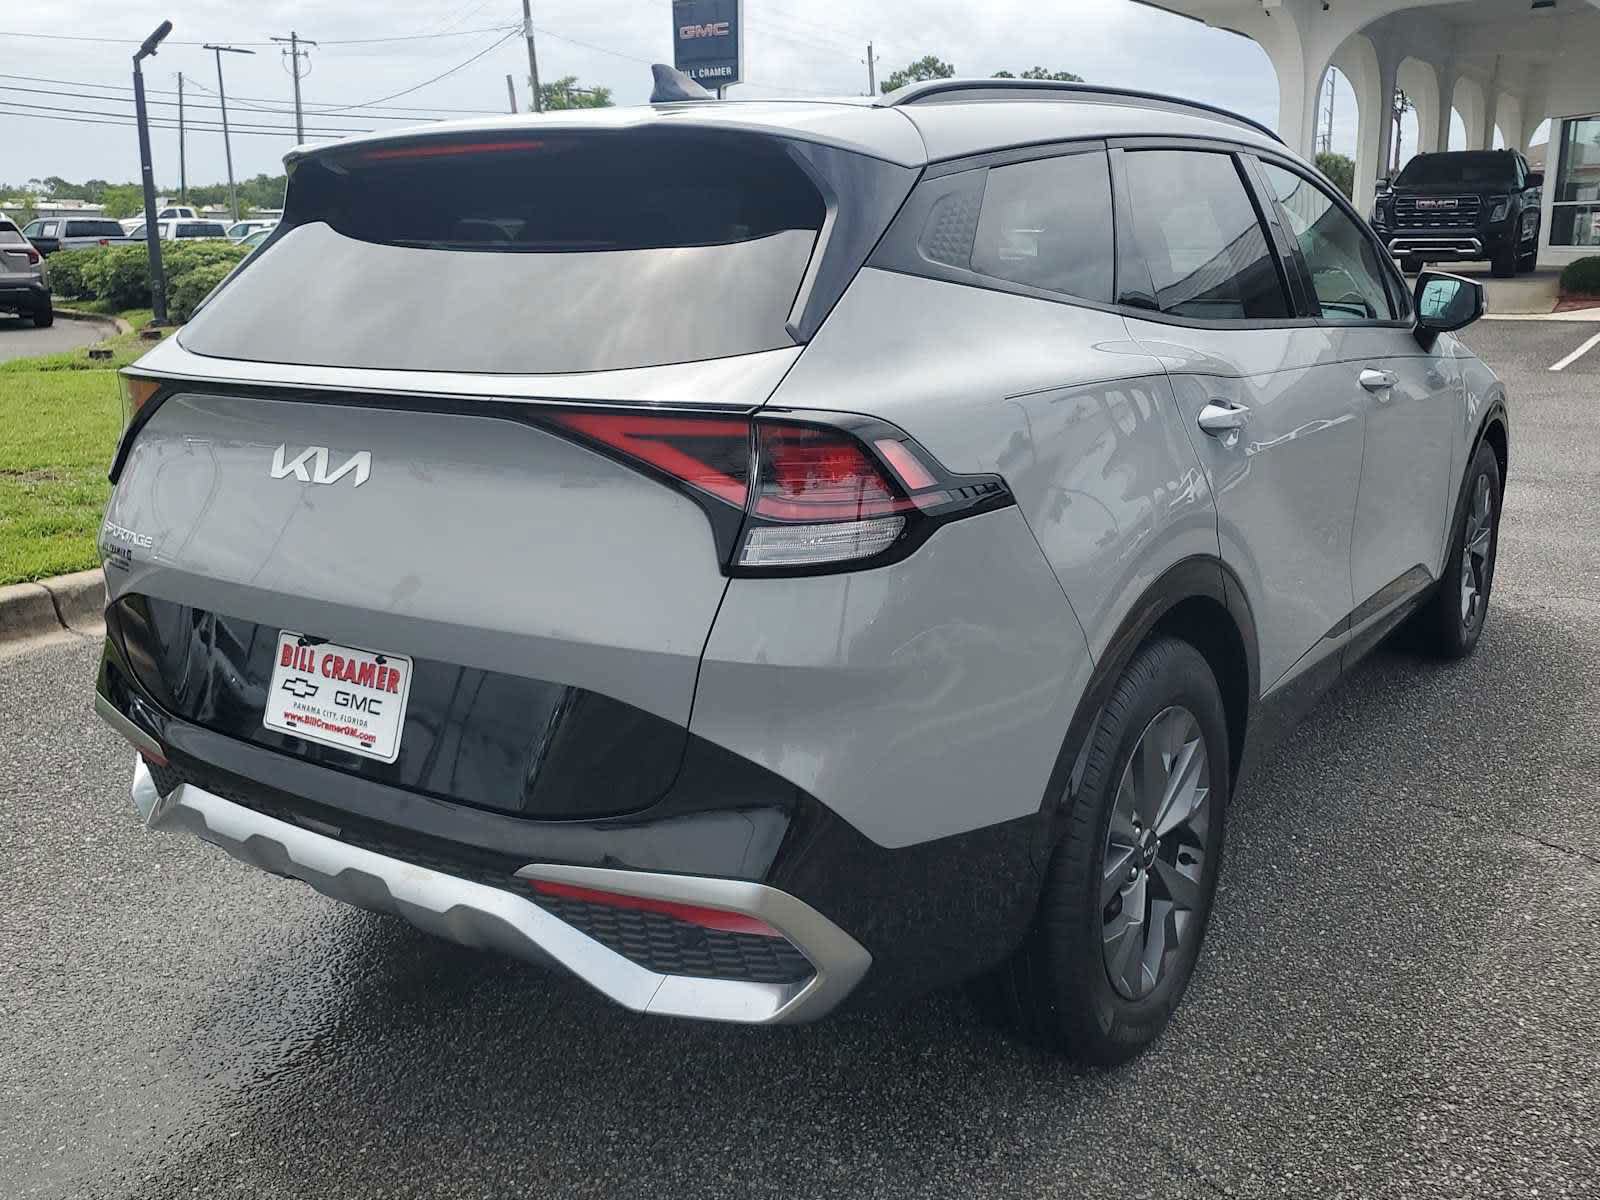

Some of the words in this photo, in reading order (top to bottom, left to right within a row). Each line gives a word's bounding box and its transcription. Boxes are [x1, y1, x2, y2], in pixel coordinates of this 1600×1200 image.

[679, 22, 729, 39] GMC
[698, 66, 732, 78] CRAMER
[1418, 200, 1456, 209] GMC
[270, 443, 372, 488] KIA
[280, 643, 316, 674] BILL
[321, 653, 401, 695] CRAMER
[293, 701, 321, 715] PANAMA
[322, 709, 338, 721] CITY,
[340, 714, 369, 728] FLORIDA
[334, 690, 383, 716] GMC
